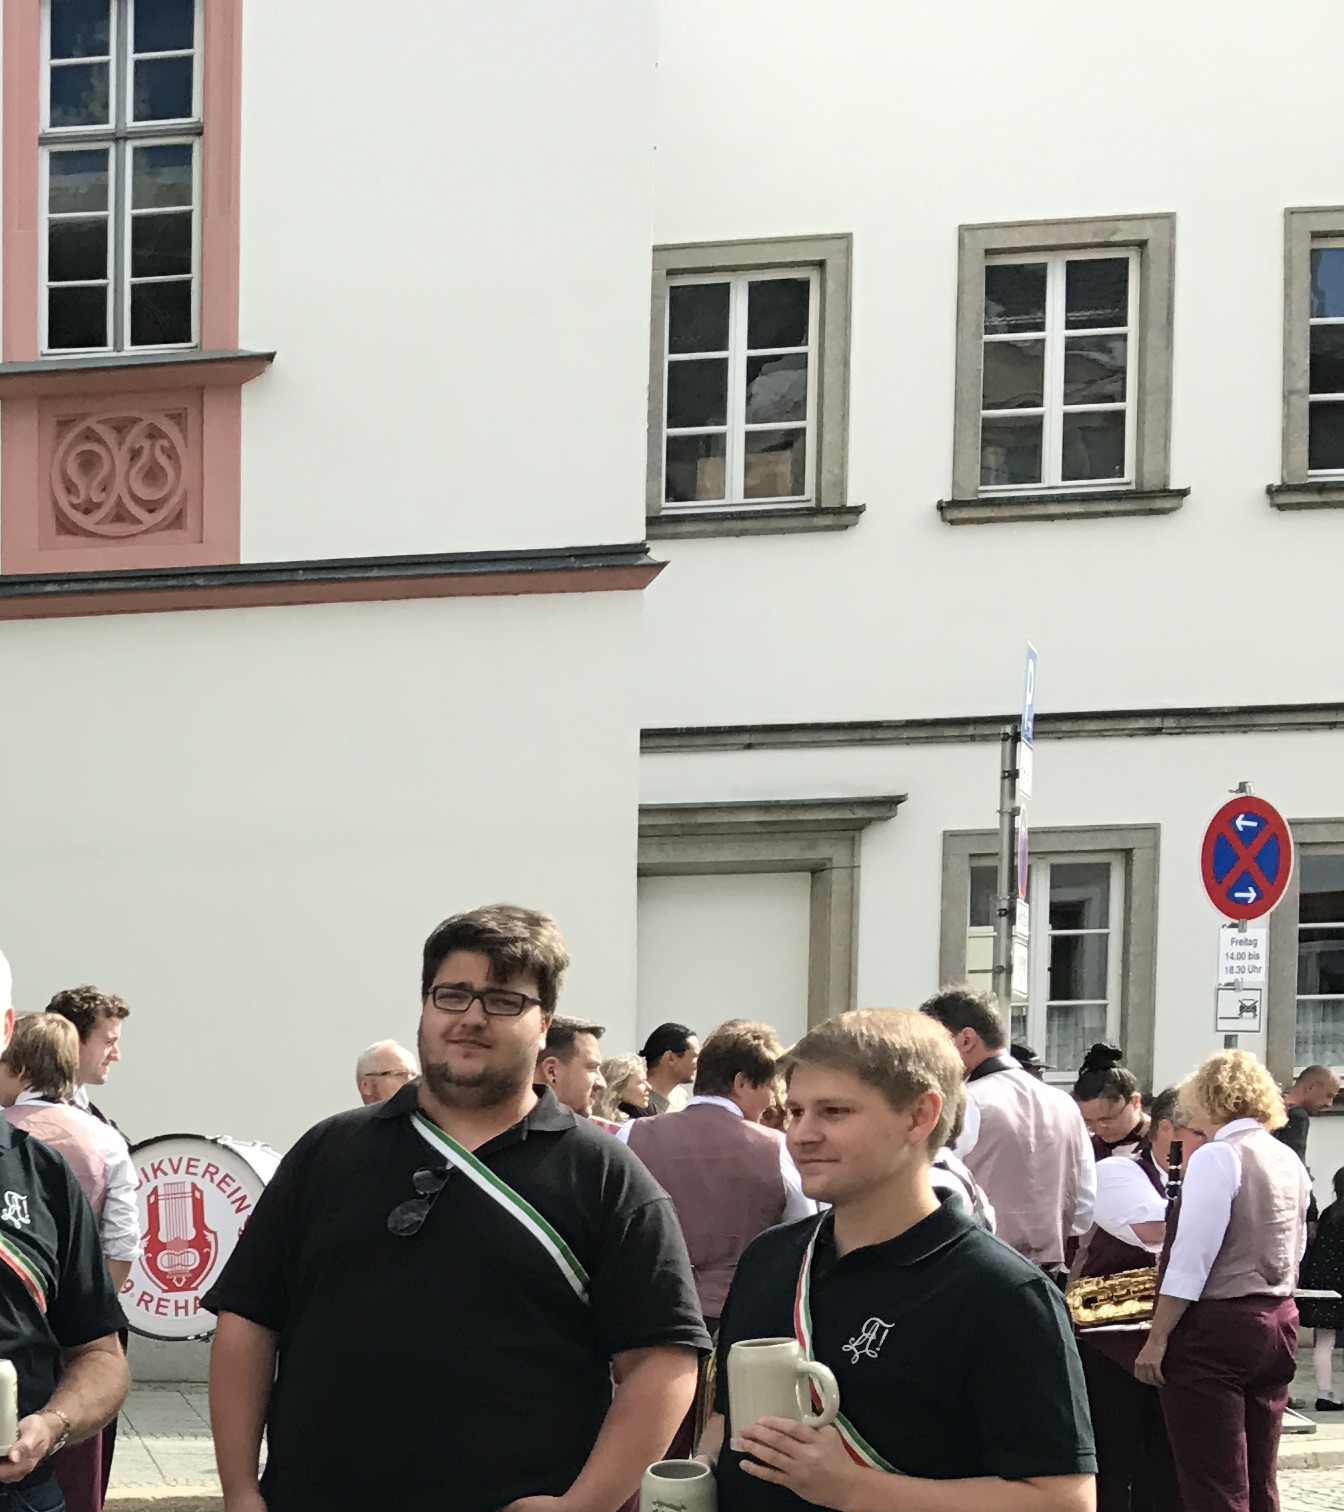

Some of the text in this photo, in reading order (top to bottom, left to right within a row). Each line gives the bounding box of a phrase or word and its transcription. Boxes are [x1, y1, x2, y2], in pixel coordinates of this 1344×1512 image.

[1230, 936, 1258, 949] Freitag
[1225, 950, 1260, 961] 14.00 bis
[1247, 964, 1262, 974] Uhr
